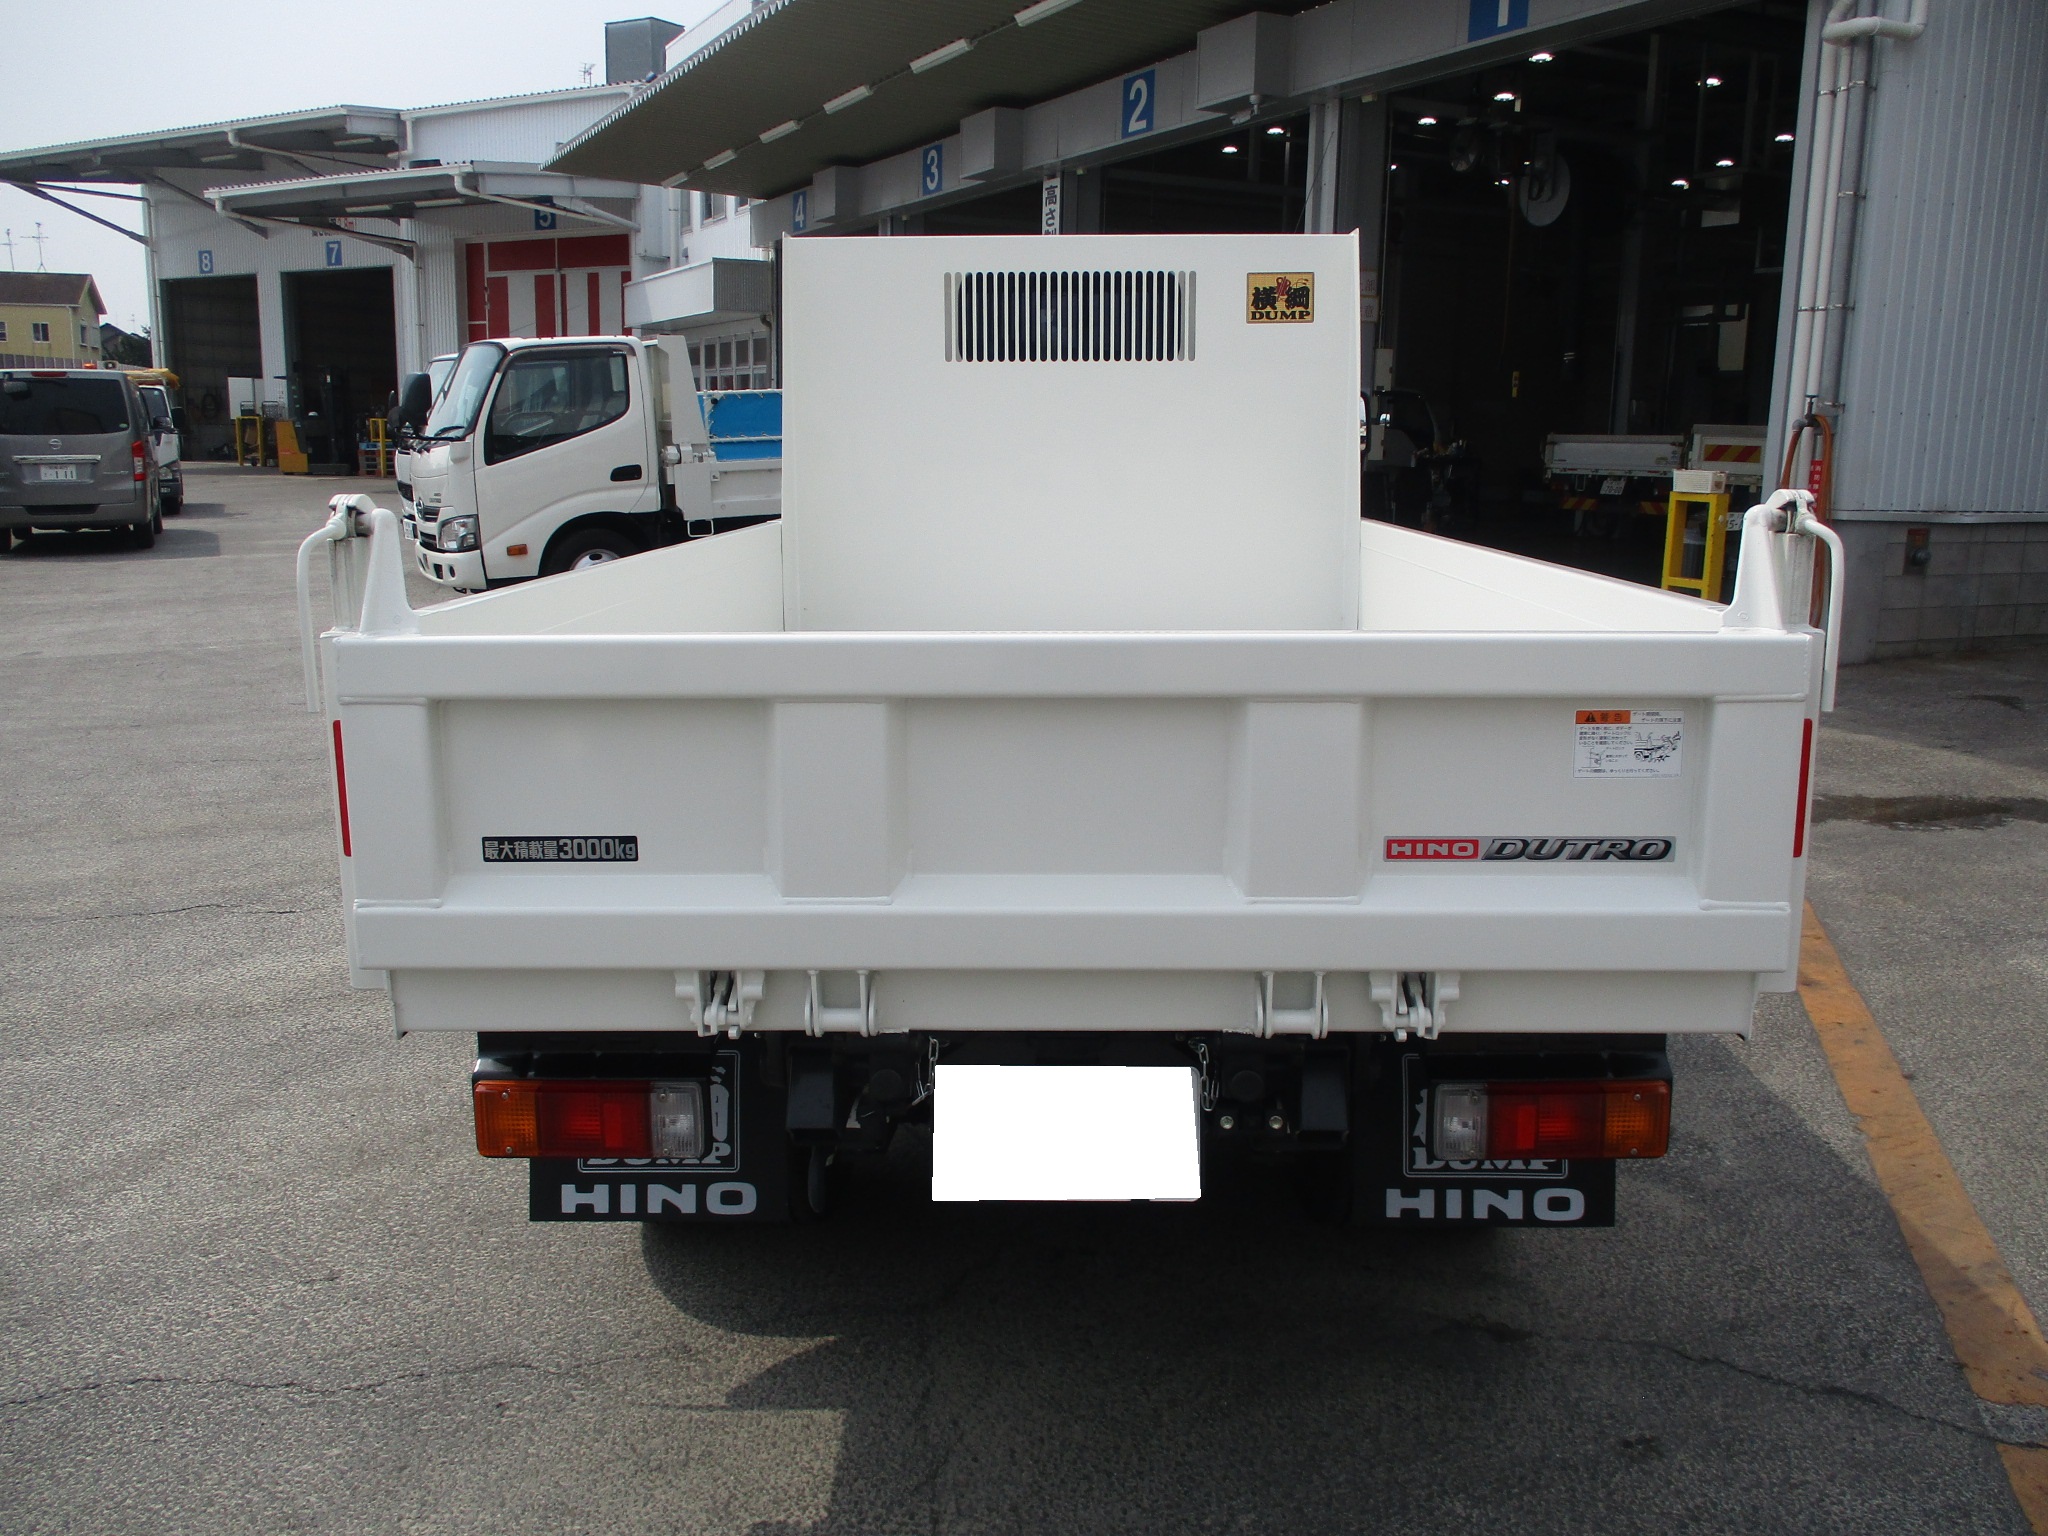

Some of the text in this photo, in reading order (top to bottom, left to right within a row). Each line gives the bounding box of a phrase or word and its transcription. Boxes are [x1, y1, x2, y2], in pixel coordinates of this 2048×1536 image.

[1128, 78, 1148, 133] 2
[926, 149, 939, 191] 3
[794, 195, 805, 228] 4
[201, 252, 211, 272] 8
[329, 243, 339, 264] 7
[1250, 310, 1311, 321] DUMP
[1391, 838, 1672, 861] HINO DUTRO
[560, 1181, 757, 1215] HINO
[1385, 1187, 1585, 1221] HINO
